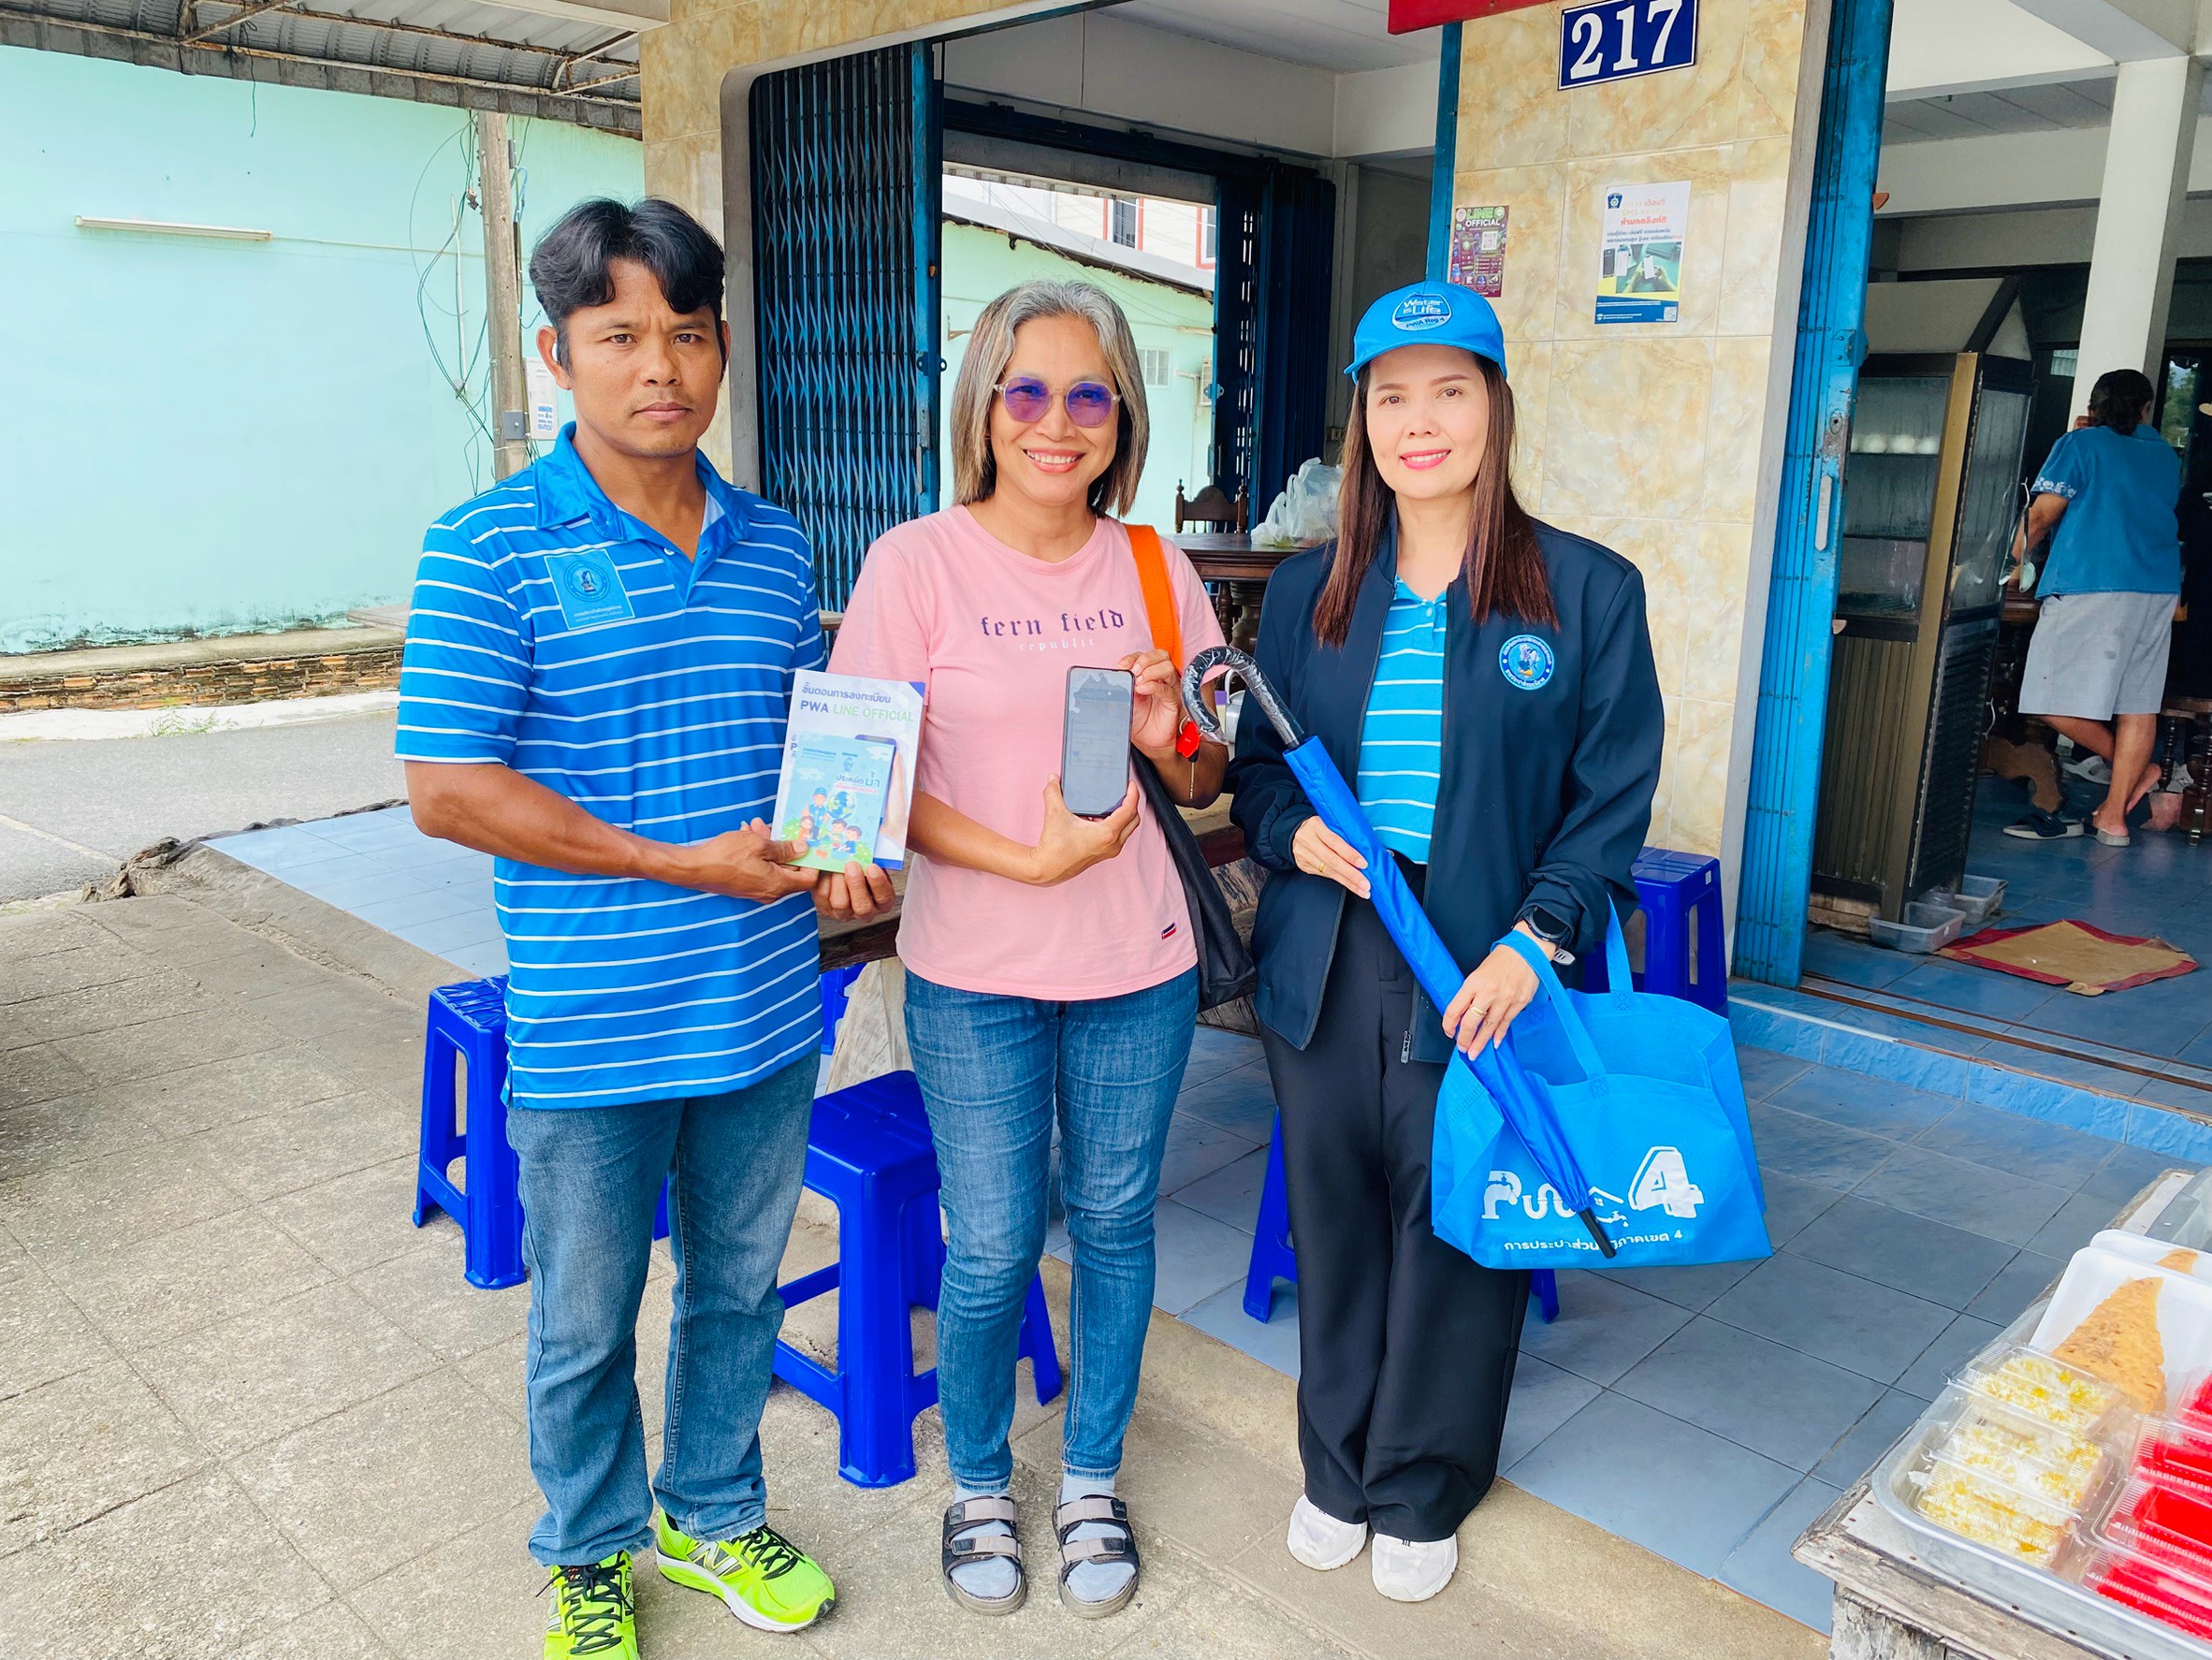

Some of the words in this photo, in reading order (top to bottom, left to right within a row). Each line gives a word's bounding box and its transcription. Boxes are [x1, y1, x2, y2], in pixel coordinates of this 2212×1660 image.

[1570, 0, 1682, 80] 217
[1466, 208, 1494, 219] LINE
[1465, 219, 1500, 227] OFFICIAL
[1404, 299, 1443, 308] Water
[1412, 305, 1442, 314] Life
[981, 617, 1042, 636] fern
[1061, 609, 1124, 633] field
[1019, 638, 1095, 652] republic
[802, 681, 892, 704] ขั้นตอนการลงทะเบียน
[800, 700, 829, 713] PWA
[833, 704, 859, 717] LINE
[863, 707, 914, 722] OFFICIAL
[1674, 1230, 1683, 1240] 4
